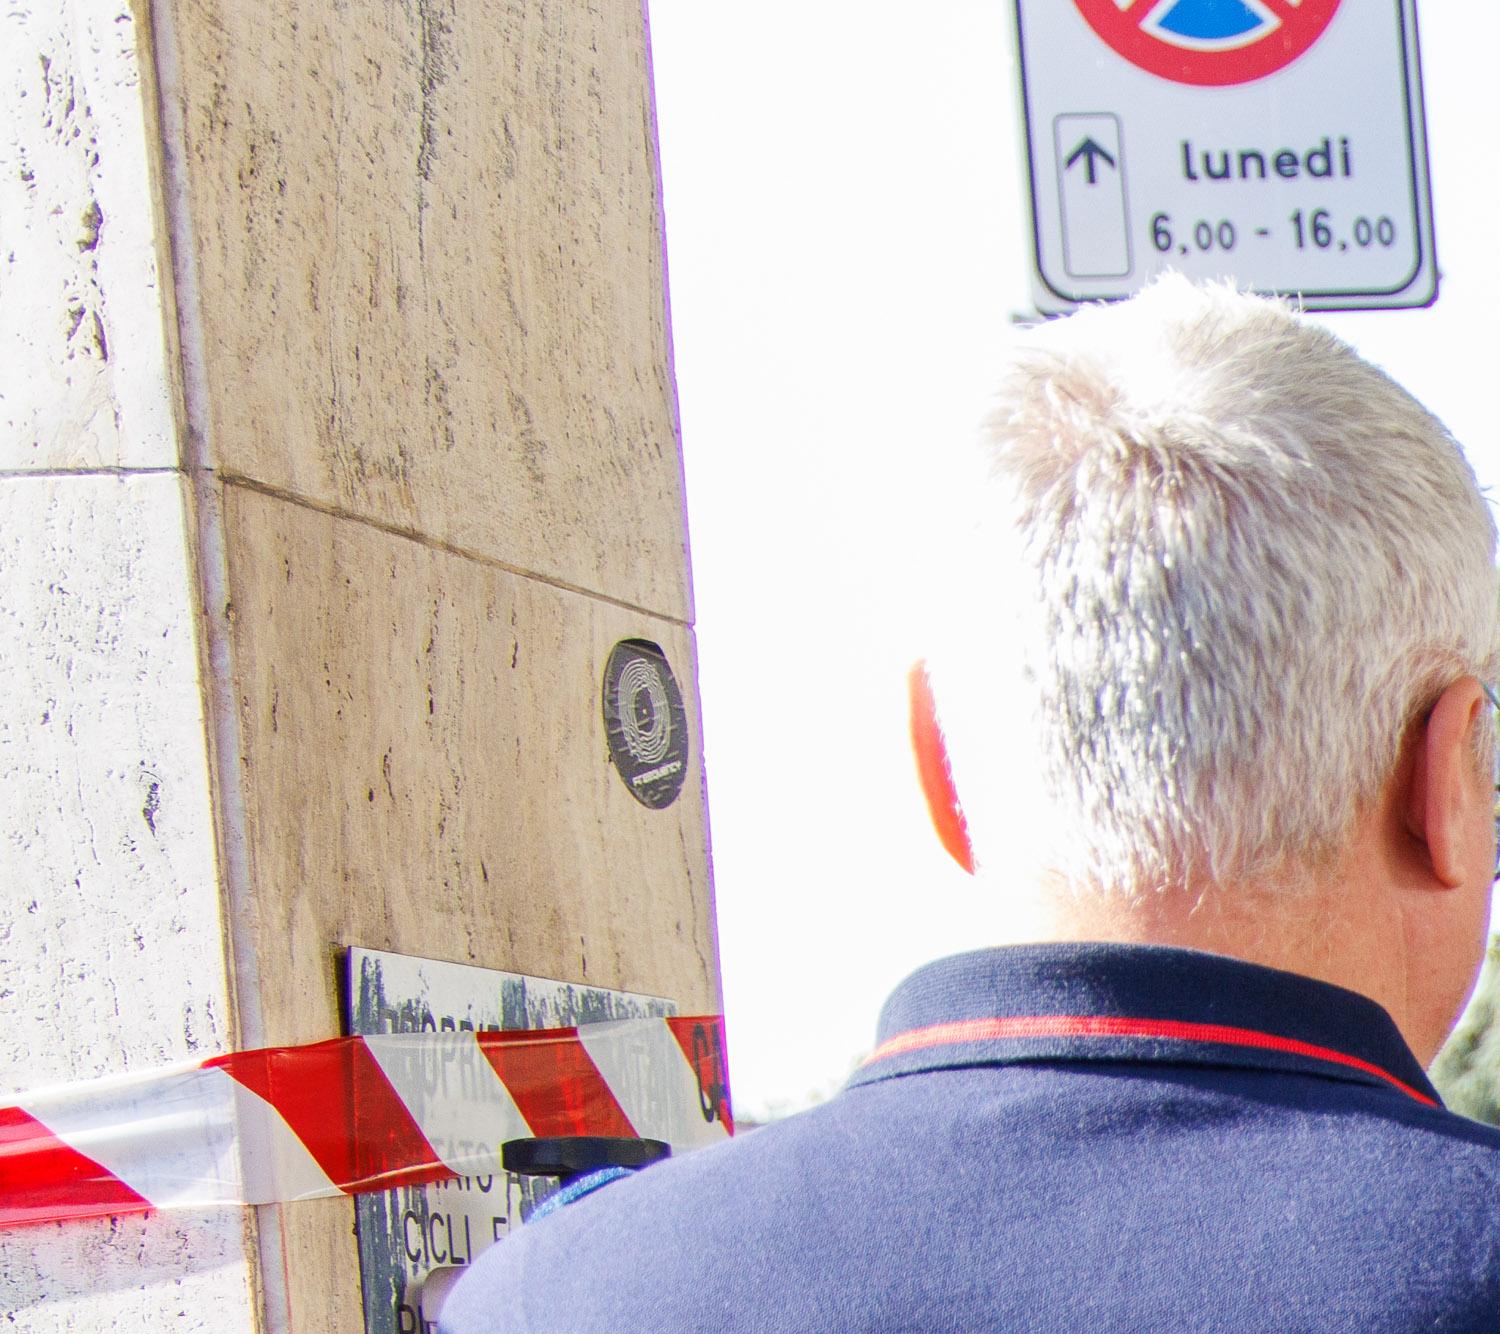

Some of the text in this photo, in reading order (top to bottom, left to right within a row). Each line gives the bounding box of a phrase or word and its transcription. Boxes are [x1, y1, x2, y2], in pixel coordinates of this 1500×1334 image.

[1149, 212, 1236, 256] 6,00
[1290, 208, 1396, 254] 16,00
[402, 1210, 472, 1267] CICLI
